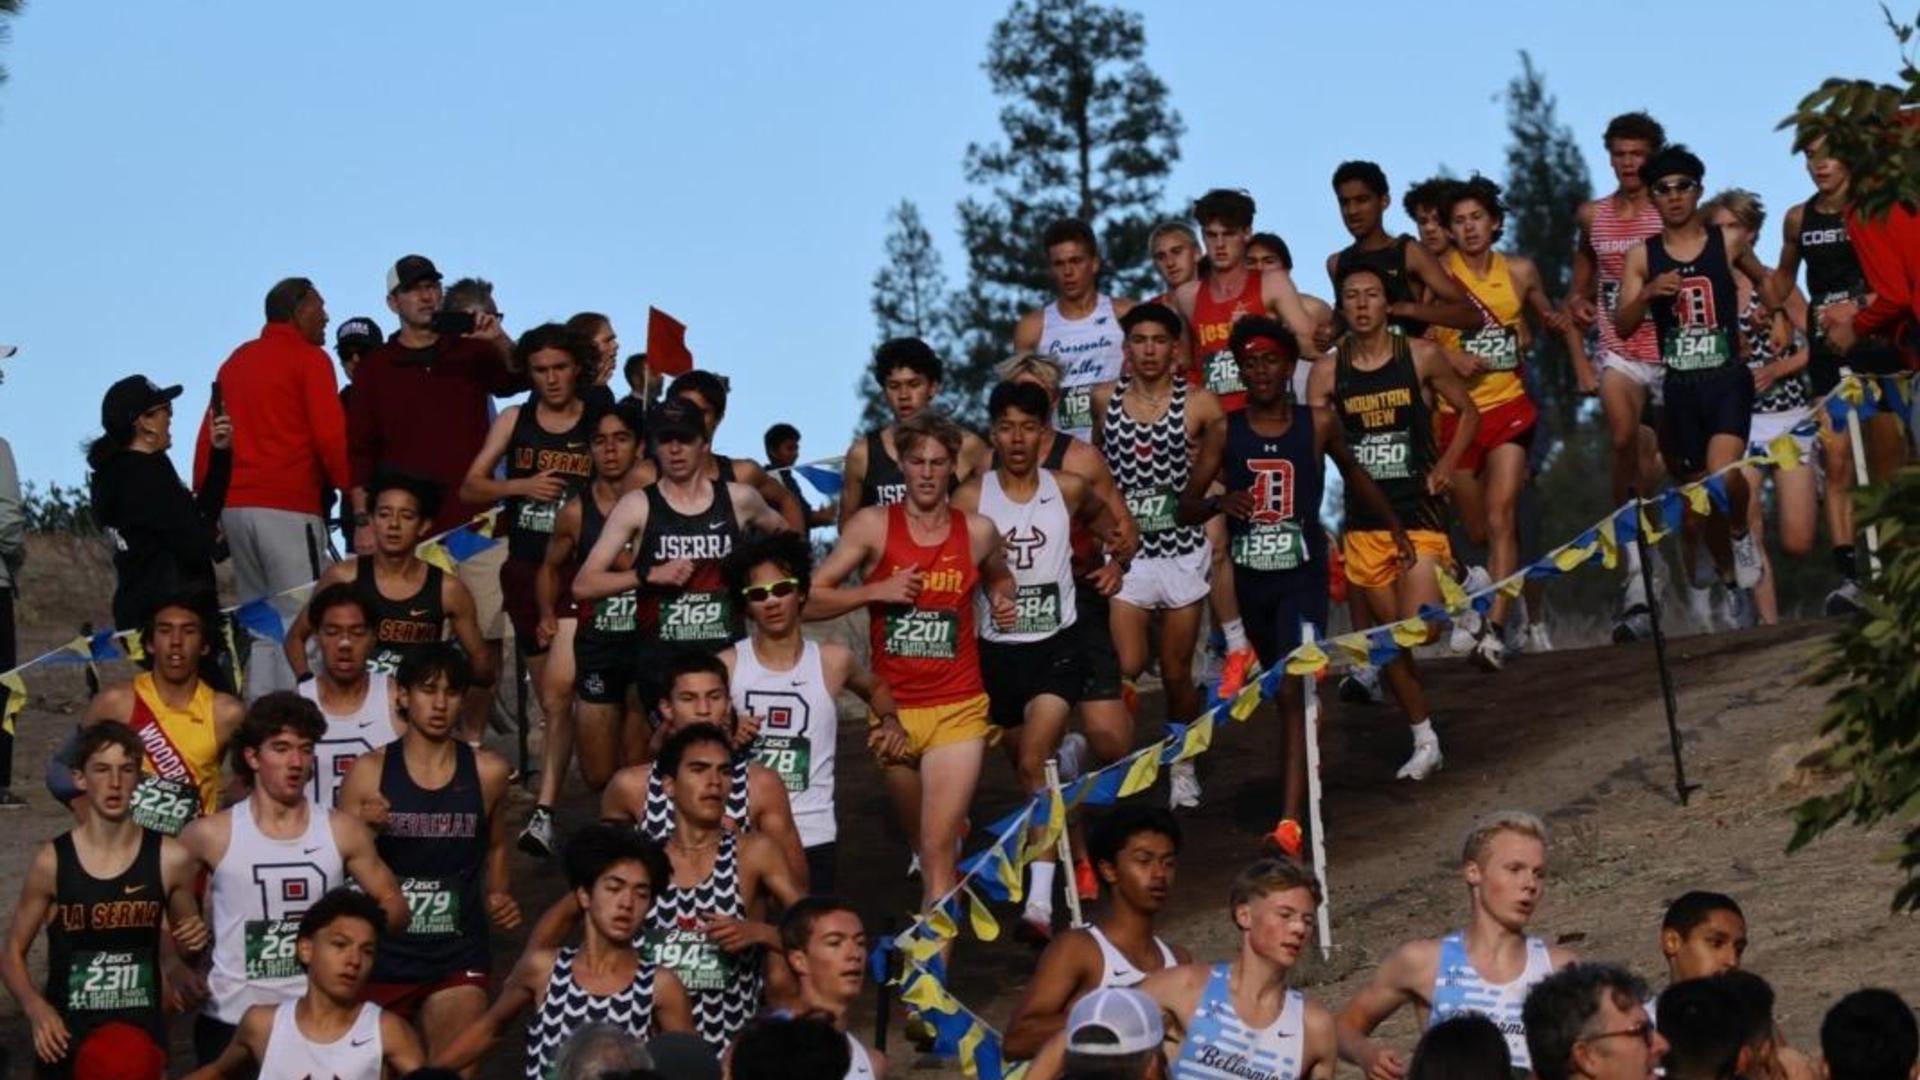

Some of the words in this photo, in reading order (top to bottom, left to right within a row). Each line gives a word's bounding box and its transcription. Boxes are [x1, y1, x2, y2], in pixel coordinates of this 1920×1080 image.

[1465, 334, 1517, 358] 5224
[1674, 335, 1716, 356] 1341
[1344, 387, 1411, 414] MOUNTAIN
[1361, 408, 1396, 429] VIEW
[654, 534, 733, 560] JSERRA
[1241, 533, 1294, 556] 1359
[667, 602, 721, 625] 2169
[893, 618, 950, 642] 2201
[653, 943, 720, 970] 1945
[83, 963, 140, 993] 2311
